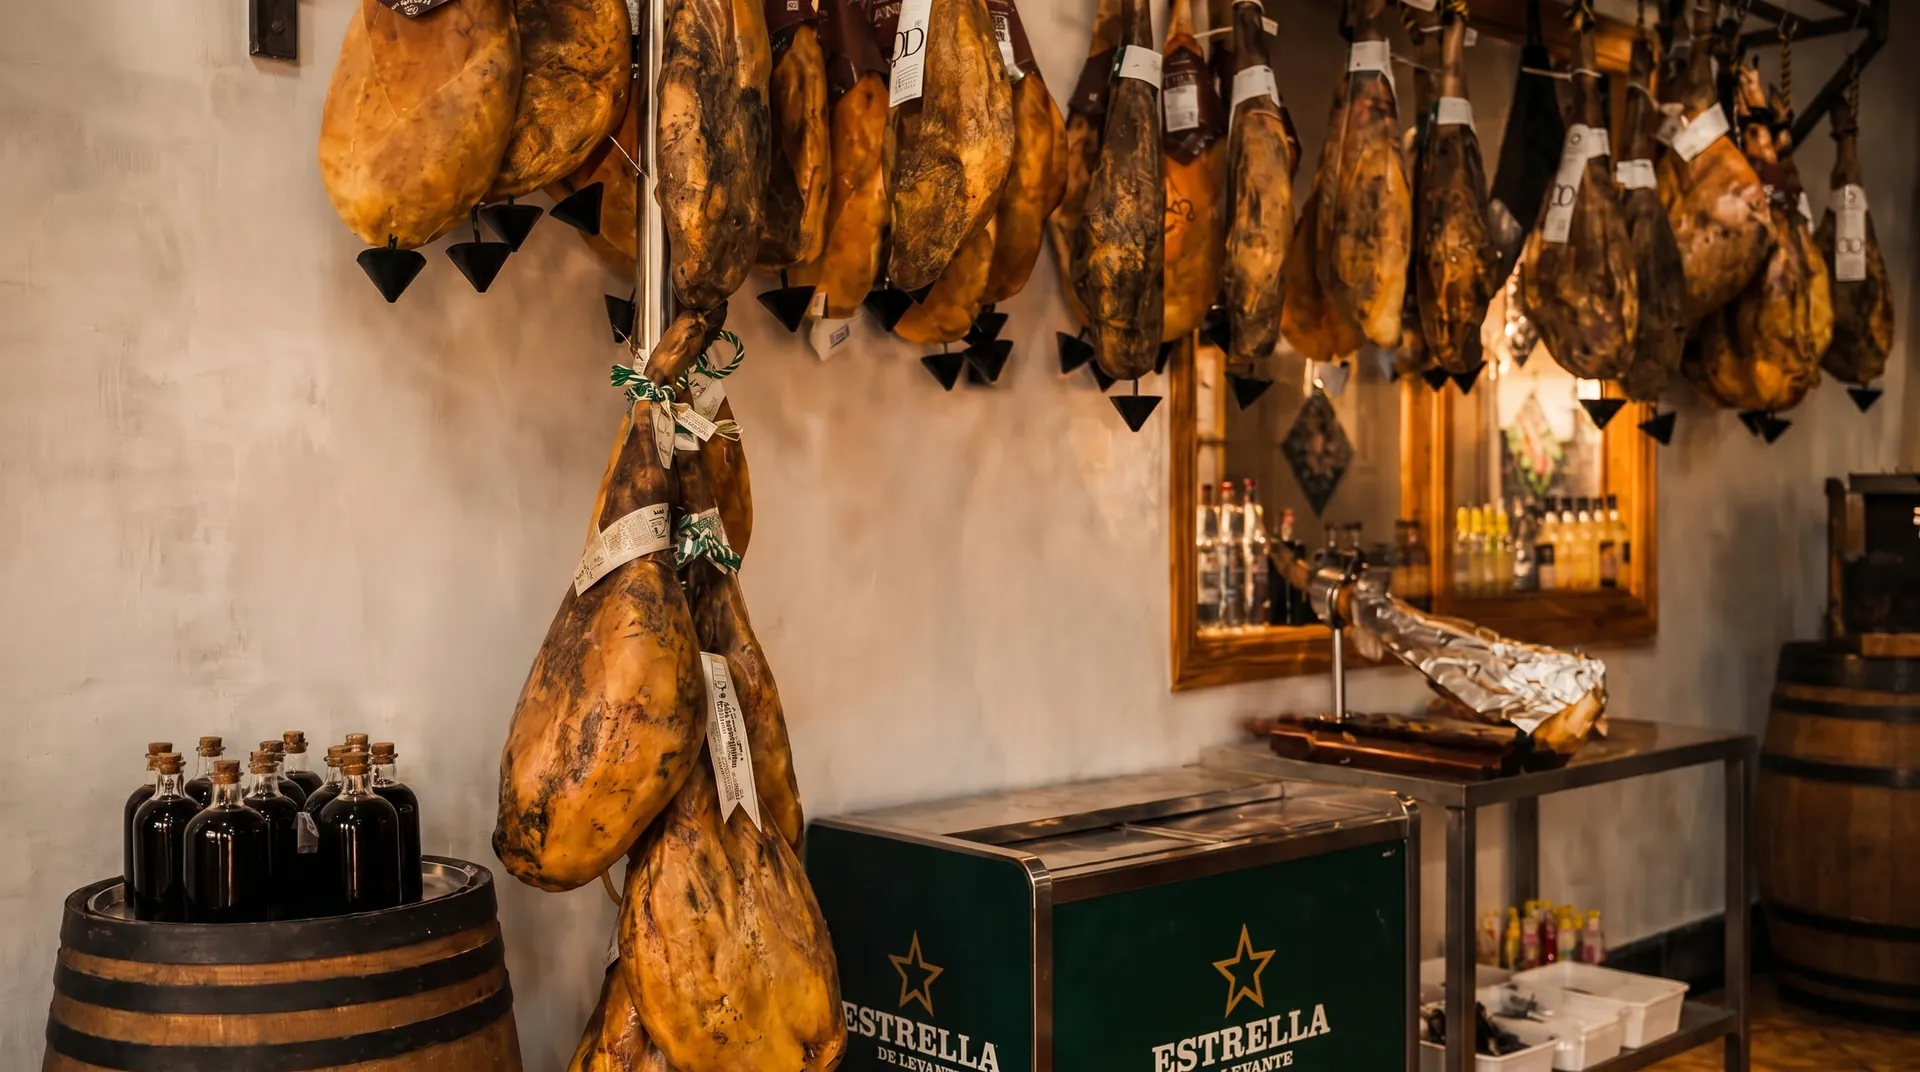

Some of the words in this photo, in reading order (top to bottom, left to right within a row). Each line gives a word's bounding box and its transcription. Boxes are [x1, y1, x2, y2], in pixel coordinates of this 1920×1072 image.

[841, 1000, 1000, 1072] ESTRELLA
[877, 1046, 897, 1065] DE
[899, 1052, 961, 1072] LEVAN
[1152, 1003, 1331, 1072] ESTRELLA
[1220, 1050, 1293, 1072] VANTE
